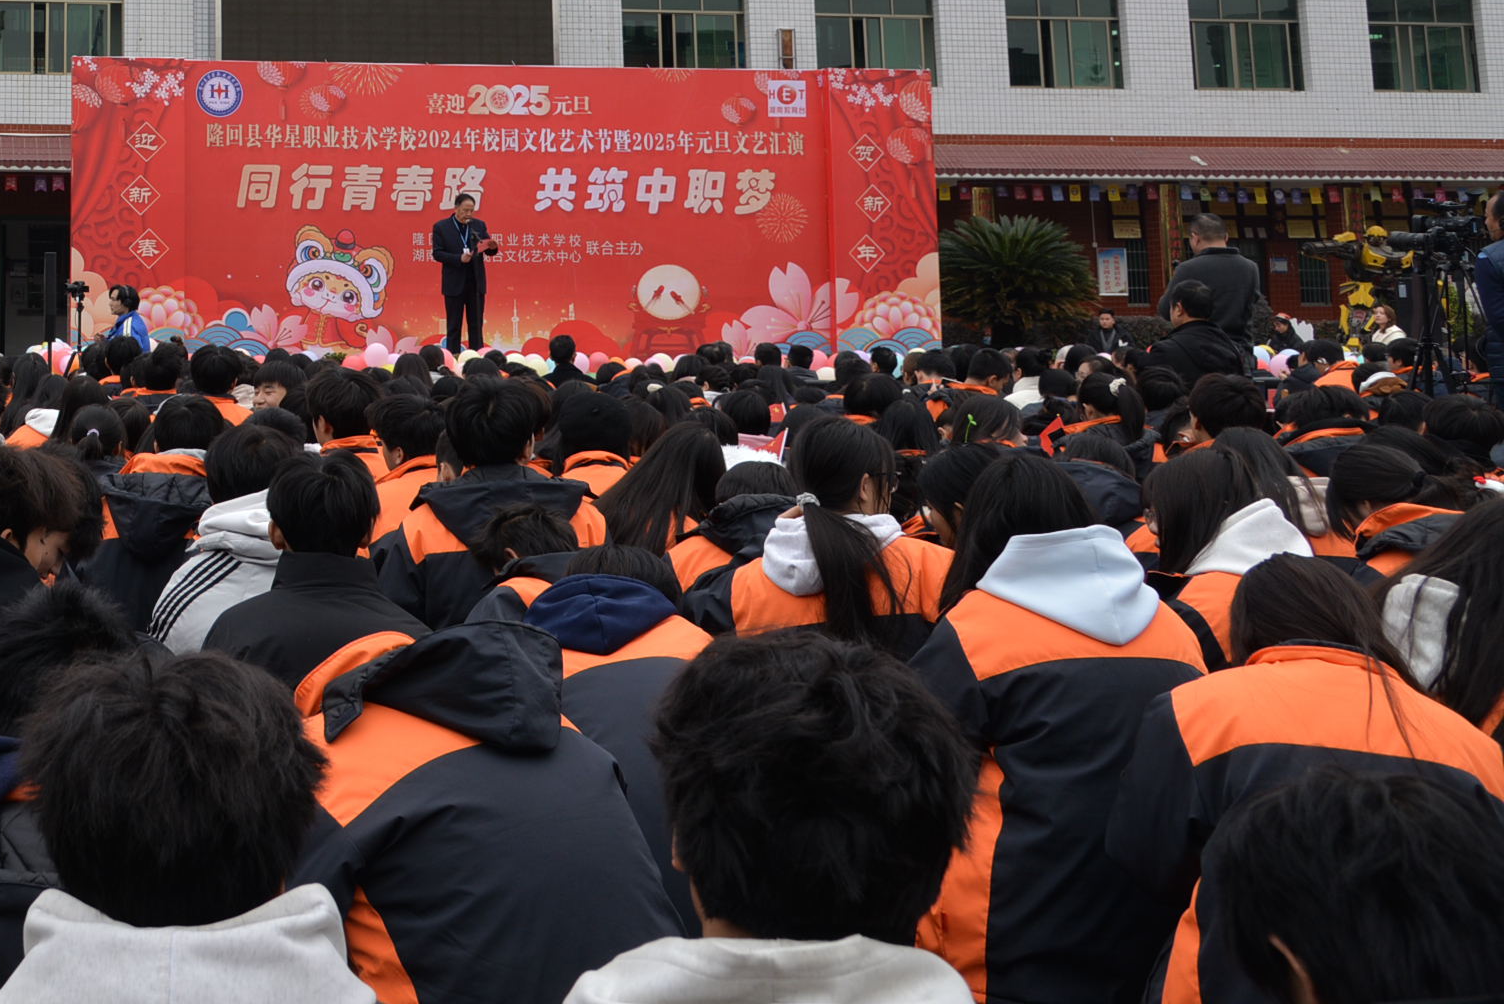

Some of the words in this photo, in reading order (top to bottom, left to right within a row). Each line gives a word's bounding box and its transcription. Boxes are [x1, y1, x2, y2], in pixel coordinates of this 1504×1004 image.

[206, 123, 805, 156] 隆回县华星职业技术学校2024年校园文化艺术节暨2025年元旦文艺汇演
[236, 163, 486, 211] 同行青春路
[534, 167, 776, 215] 共筑中职梦
[585, 240, 643, 256] 联合主办
